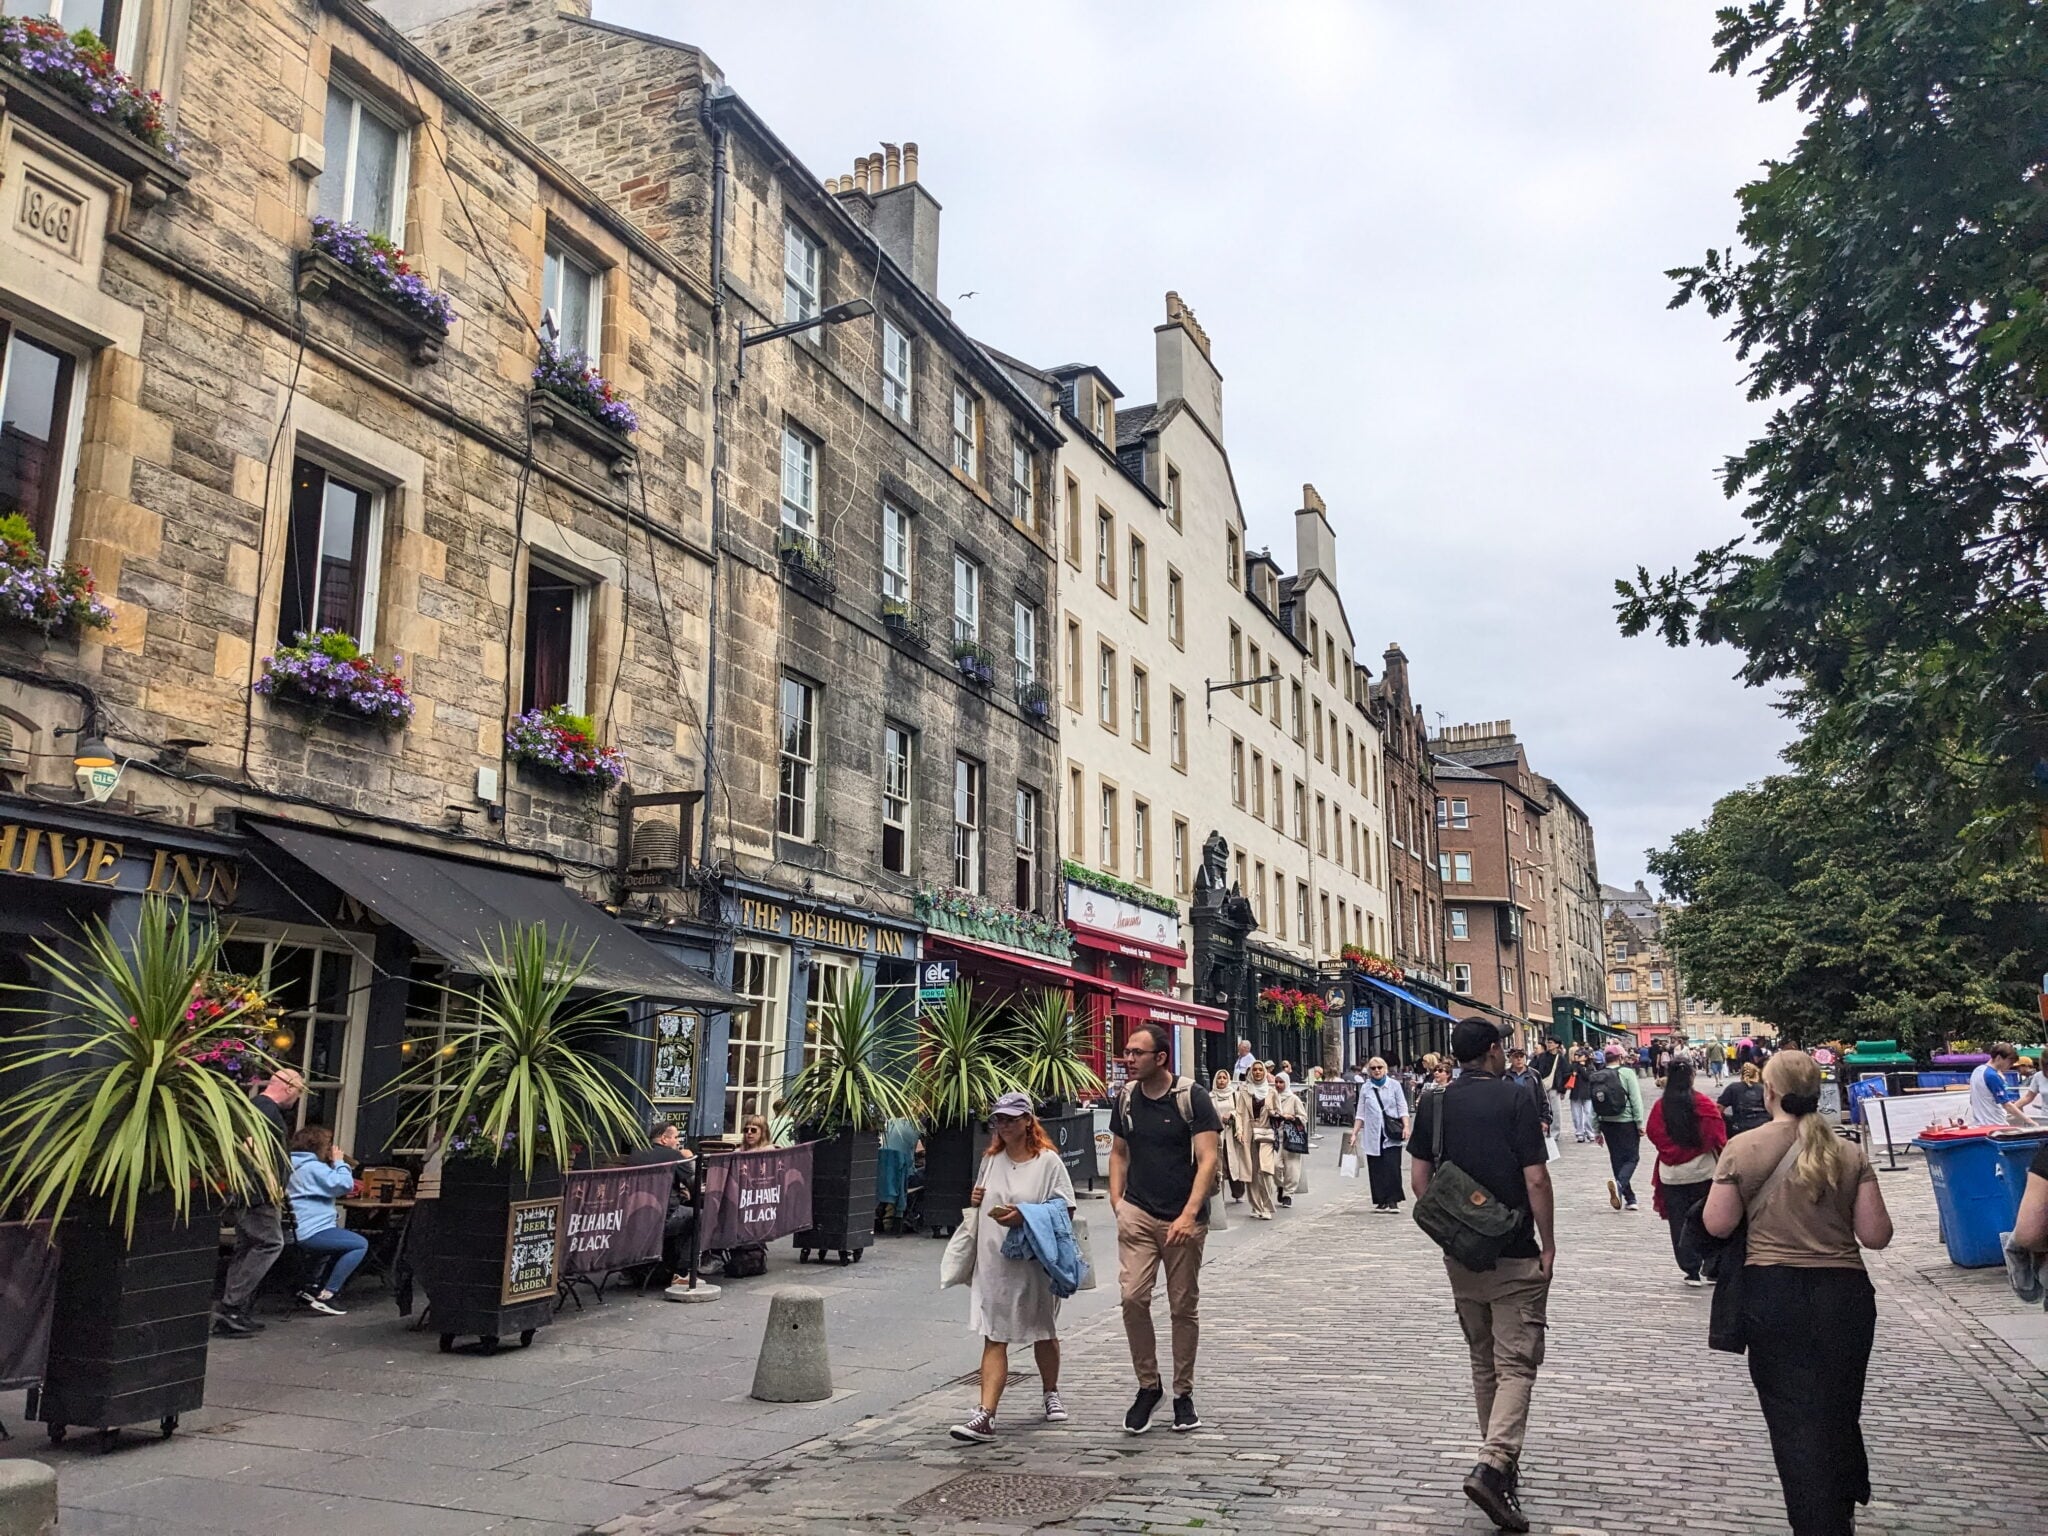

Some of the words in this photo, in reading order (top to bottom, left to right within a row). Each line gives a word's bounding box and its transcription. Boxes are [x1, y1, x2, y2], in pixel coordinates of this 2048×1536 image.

[20, 186, 72, 244] 1868
[146, 849, 240, 906] INN
[739, 896, 783, 933] THE
[790, 909, 870, 951] BEEHIVE
[875, 927, 904, 957] INN
[926, 963, 950, 981] elc
[1251, 952, 1262, 965] THE
[1263, 956, 1279, 970] WHITE
[1279, 961, 1292, 974] HART
[1318, 1093, 1345, 1102] BELHAVEN
[666, 1112, 687, 1121] EXIT
[739, 1184, 782, 1209] BELHAVEN
[567, 1209, 624, 1237] BELHAVEN
[743, 1206, 777, 1224] BLACK
[524, 1221, 546, 1233] BEER
[569, 1234, 613, 1253] BLACK
[519, 1268, 541, 1280] BEER
[513, 1278, 547, 1293] GARDEN
